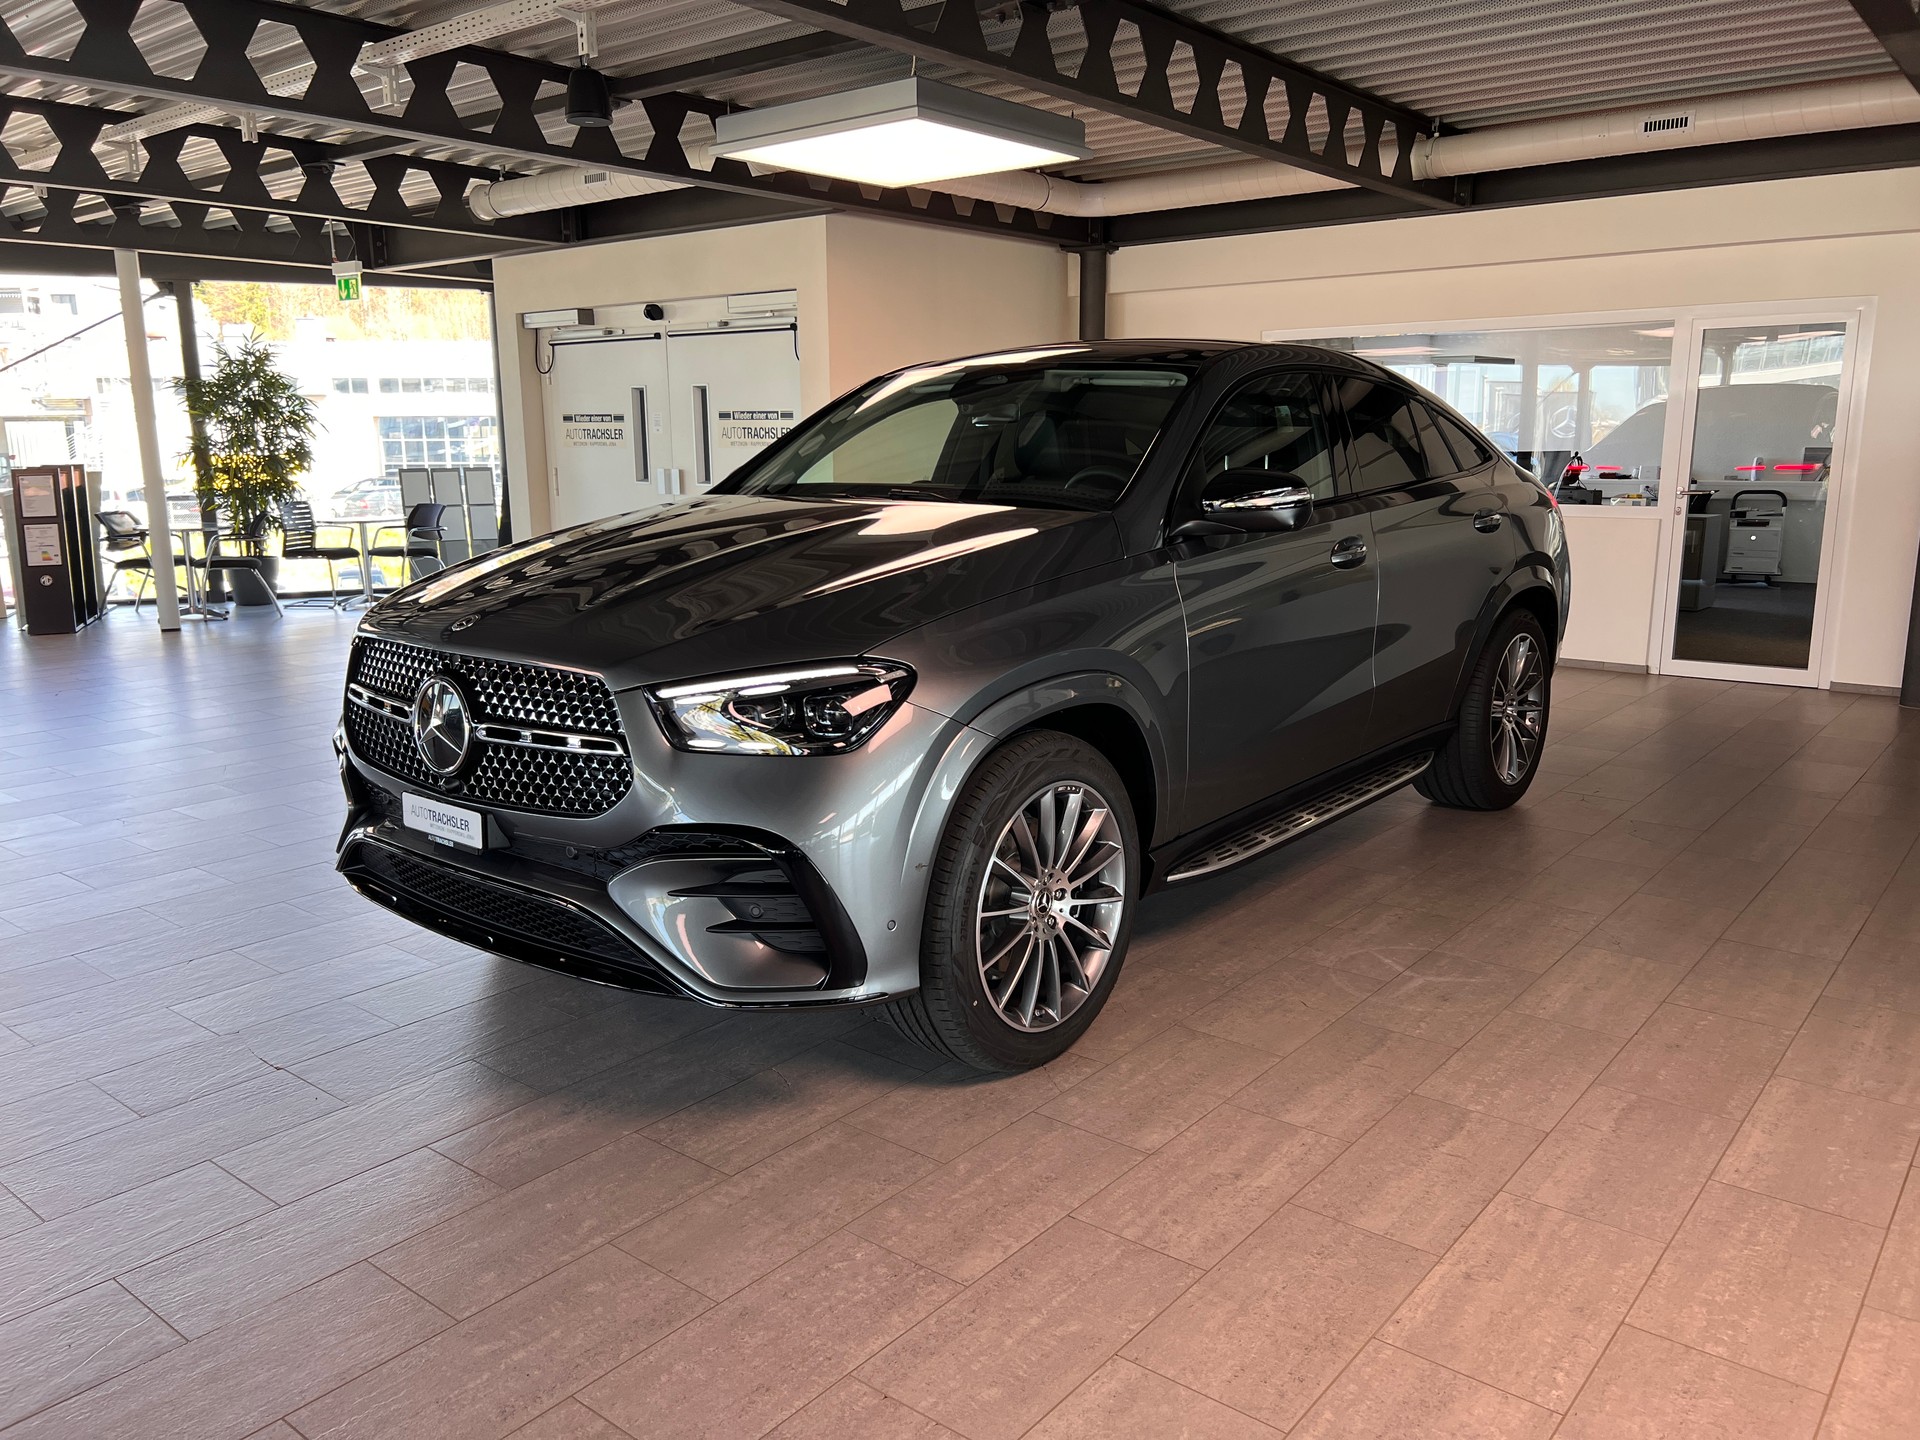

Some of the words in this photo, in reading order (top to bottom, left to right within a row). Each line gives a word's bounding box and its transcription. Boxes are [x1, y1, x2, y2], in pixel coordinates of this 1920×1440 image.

[734, 411, 752, 419] Wieder
[753, 411, 767, 419] einer
[565, 428, 624, 440] AUTOTRACHSLER
[411, 804, 470, 832] AUTOTRACHSLER
